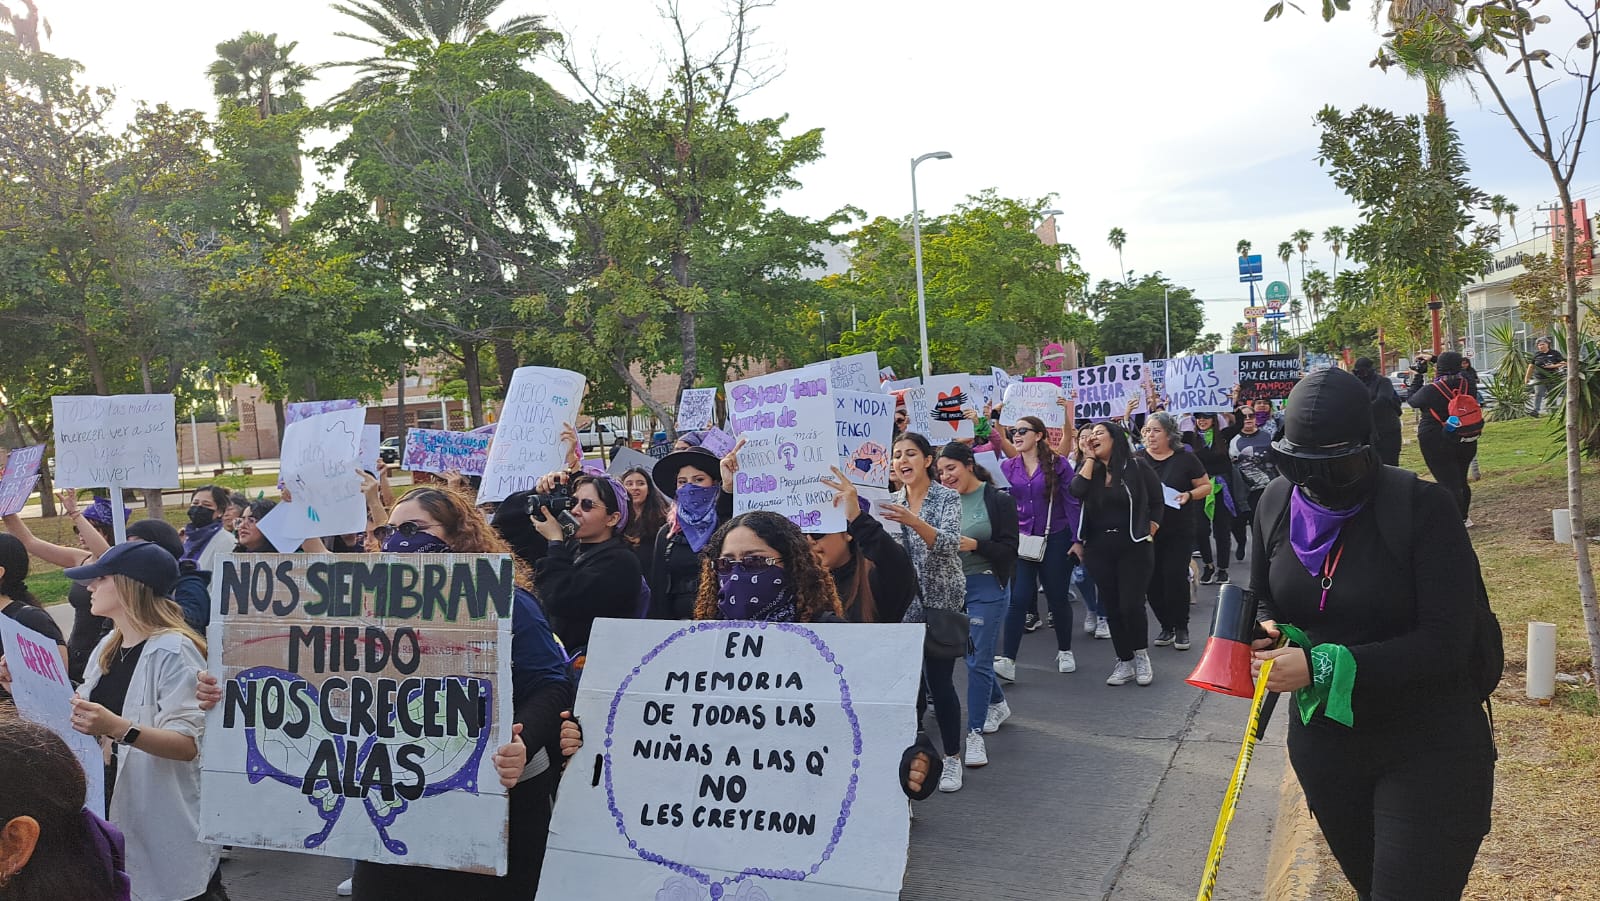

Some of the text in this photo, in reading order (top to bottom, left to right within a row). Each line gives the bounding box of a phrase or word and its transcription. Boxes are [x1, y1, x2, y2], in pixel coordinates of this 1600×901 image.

[1077, 365, 1117, 387] ESTO
[1122, 364, 1141, 381] ES
[1240, 360, 1249, 370] SI
[1252, 360, 1265, 369] NO
[1240, 371, 1258, 380] PAZ
[1260, 370, 1269, 380] EL
[1184, 371, 1219, 389] LAS
[731, 383, 787, 412] Estoy
[1079, 383, 1125, 403] PELEAR
[514, 402, 555, 424] NIÑA
[837, 397, 888, 417] X MODA
[1074, 401, 1111, 418] COMO
[731, 405, 797, 437] harta de
[835, 420, 871, 438] TENGO
[61, 421, 166, 445] merecen ver a sus
[510, 425, 535, 441] QUE
[540, 427, 557, 446] SU
[804, 446, 824, 463] QUE
[837, 442, 850, 457] LA
[736, 472, 777, 494] Puedo
[220, 558, 513, 622] NOS SEMBRAN
[288, 626, 421, 674] MIEDO
[725, 632, 764, 659] EN
[665, 671, 803, 692] MEMORIA
[223, 676, 482, 739] NOS CRECEN
[643, 701, 816, 729] DE TODAS LAS
[633, 734, 712, 766] NIÑAS
[725, 746, 741, 766] A
[753, 747, 795, 773] LAS
[301, 740, 426, 801] ALAS
[700, 774, 747, 803] NO
[640, 803, 816, 835] LES CREYERON
